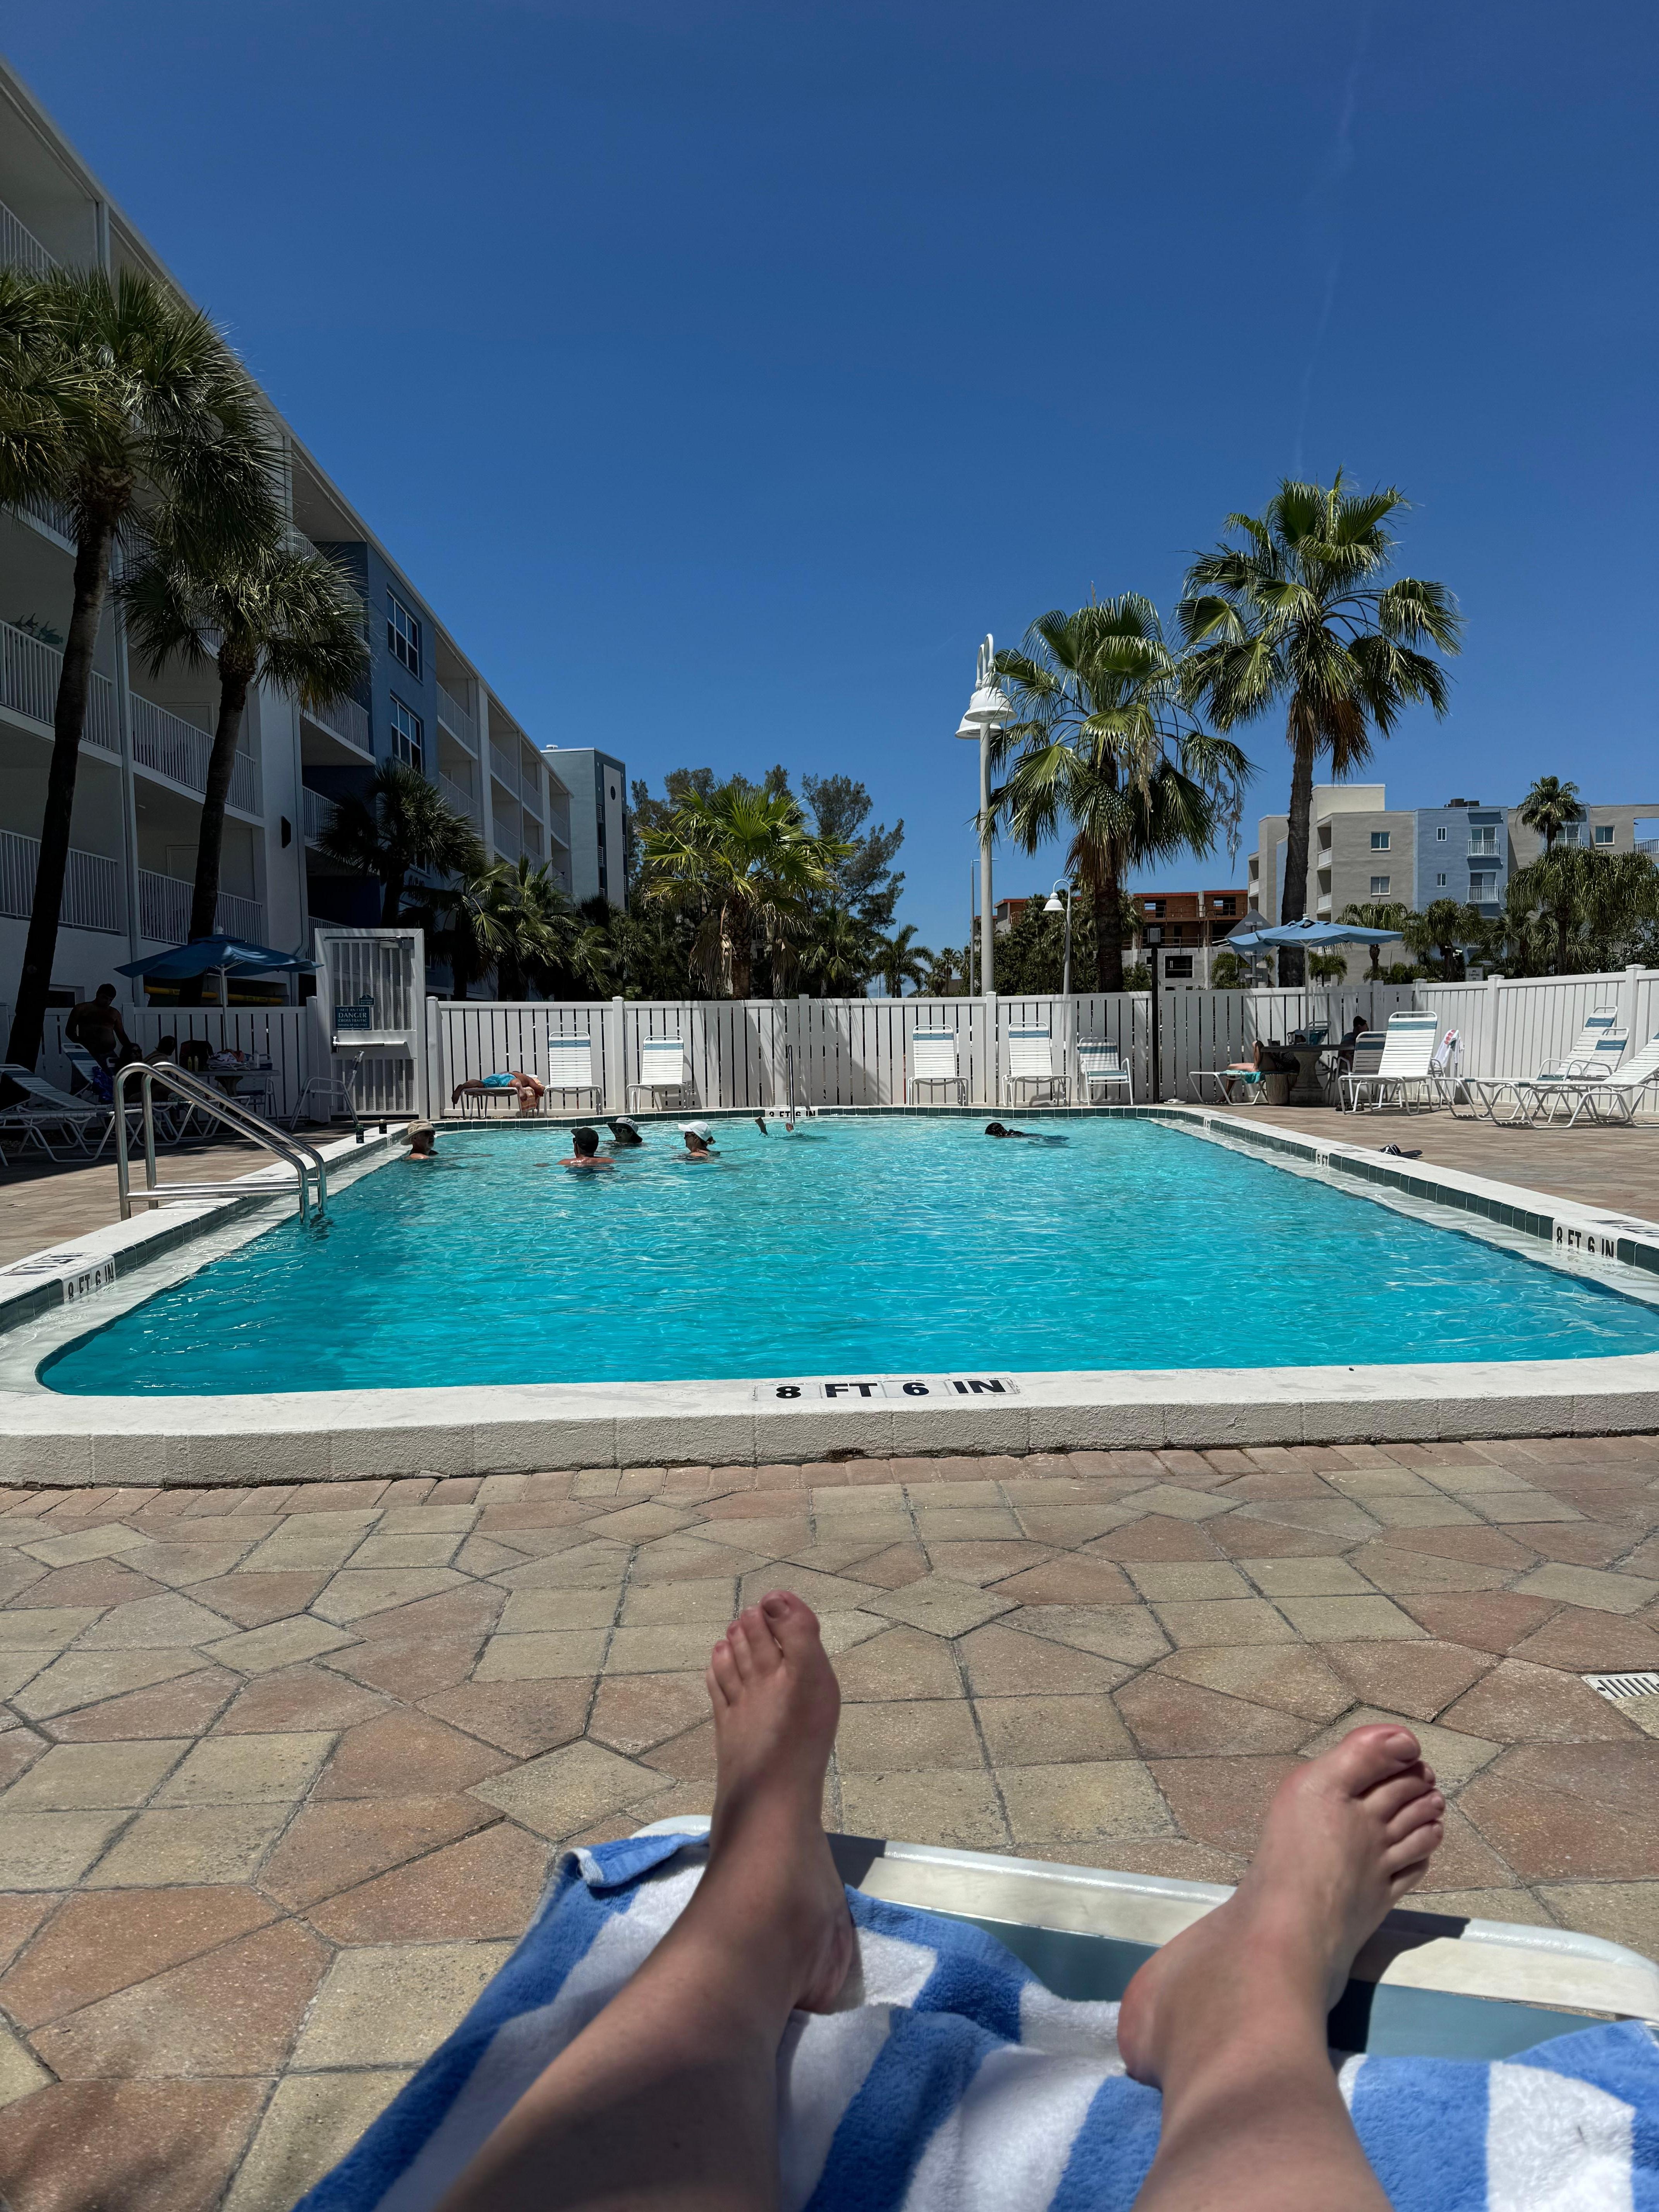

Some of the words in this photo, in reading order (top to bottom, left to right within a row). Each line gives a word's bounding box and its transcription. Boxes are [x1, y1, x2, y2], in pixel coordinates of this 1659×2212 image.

[1322, 1155, 1328, 1167] FT
[1568, 1229, 1582, 1248] FT
[1588, 1236, 1595, 1253] 6
[1601, 1238, 1614, 1258] IN
[79, 1274, 91, 1294] FT
[104, 1262, 114, 1283] IN
[776, 1386, 802, 1399] 8
[824, 1383, 878, 1398] FT
[902, 1382, 929, 1396] 6
[952, 1380, 1006, 1394] IN
